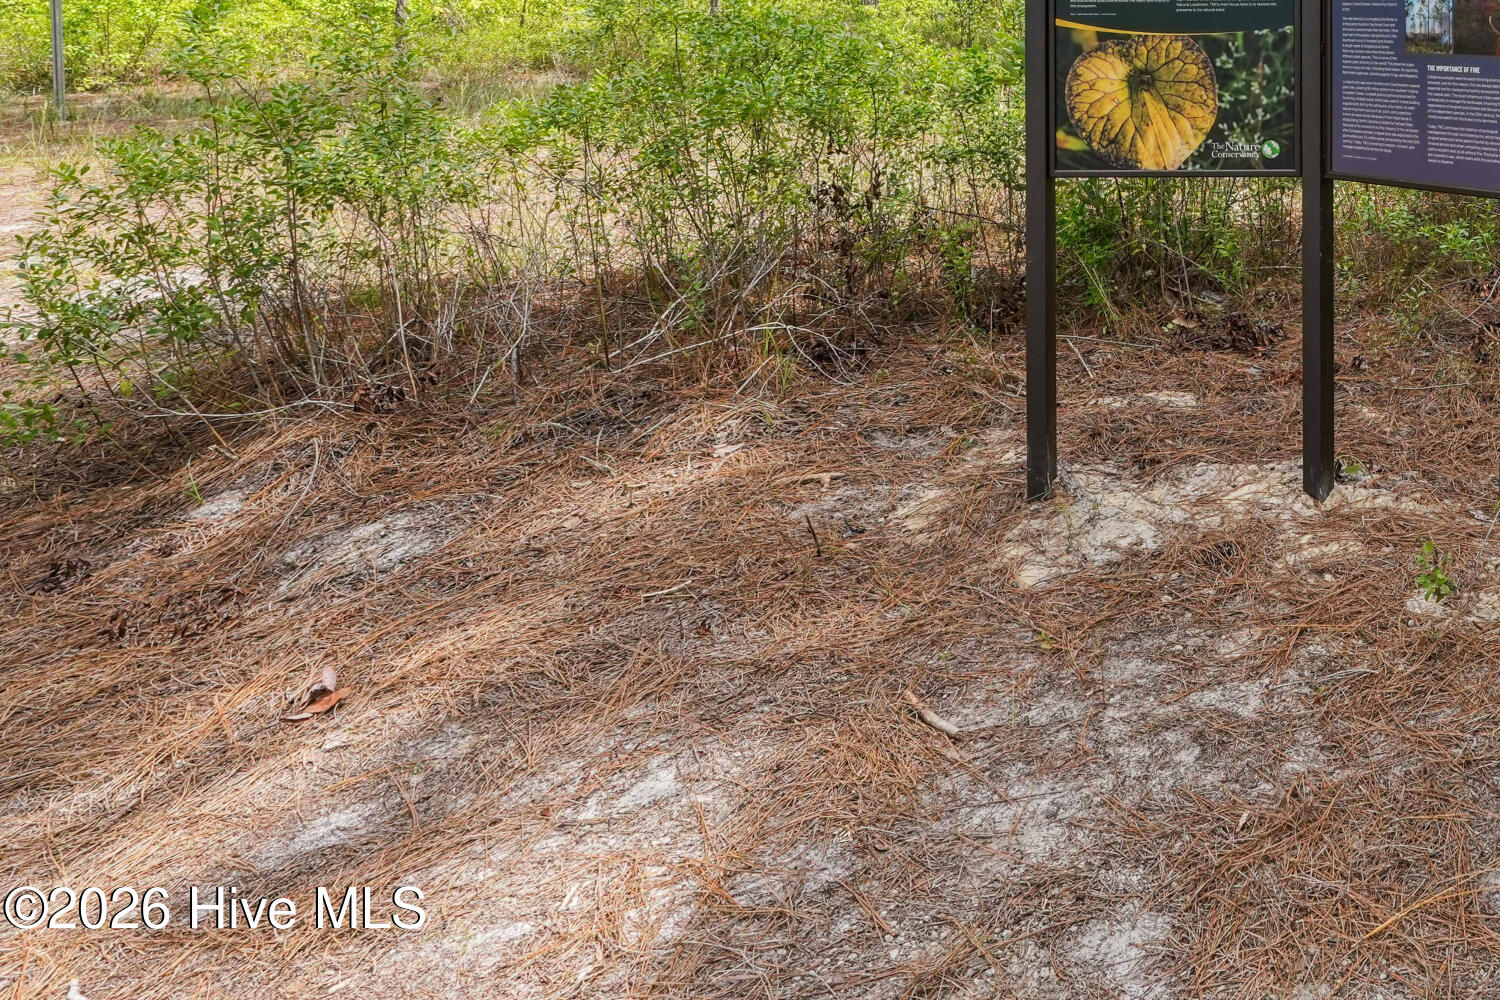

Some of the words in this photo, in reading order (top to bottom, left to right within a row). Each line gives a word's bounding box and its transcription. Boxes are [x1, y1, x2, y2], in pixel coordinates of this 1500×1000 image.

[1212, 142, 1224, 150] The
[1225, 141, 1261, 151] Nature
[1211, 150, 1260, 160] Conservancy
